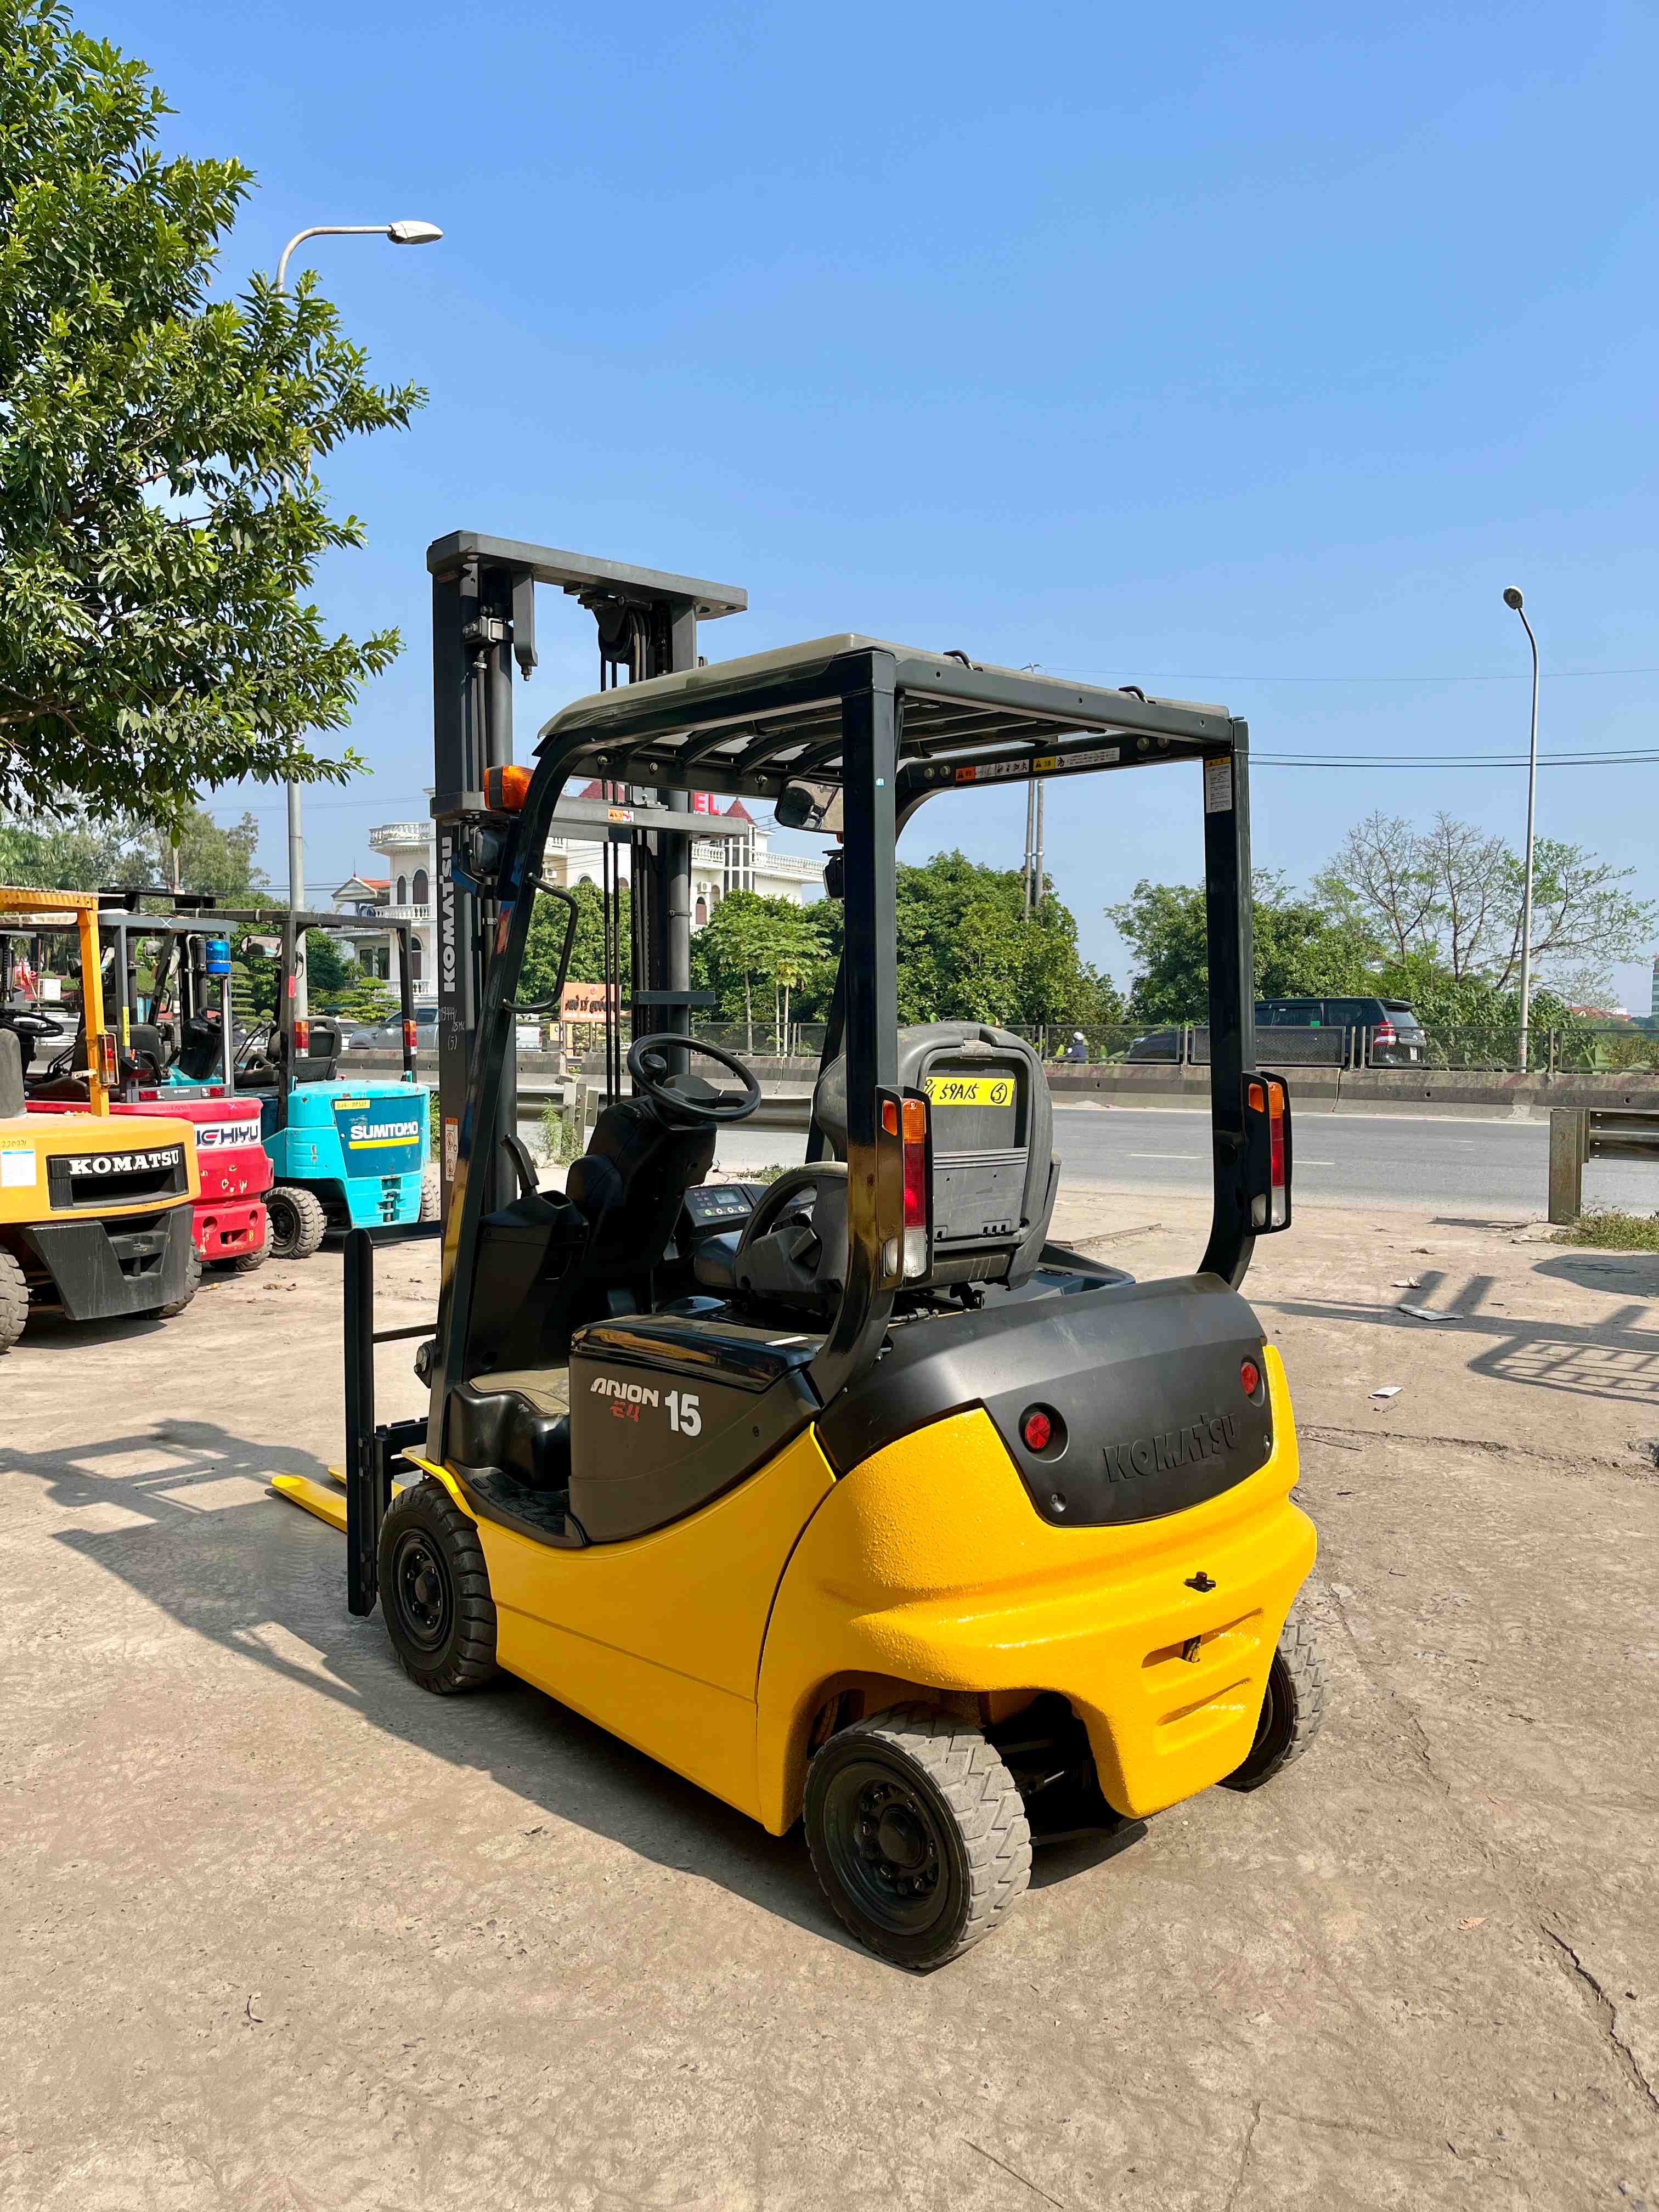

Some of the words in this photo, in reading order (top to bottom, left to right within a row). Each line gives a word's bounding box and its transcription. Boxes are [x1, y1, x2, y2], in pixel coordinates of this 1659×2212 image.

[439, 836, 456, 992] KOMATSU
[69, 1149, 179, 1175] KOMATSU
[194, 1125, 258, 1146] ICHIYU
[590, 1377, 659, 1407] ARION
[664, 1390, 702, 1437] 15
[1103, 1412, 1237, 1483] KOMATSU
